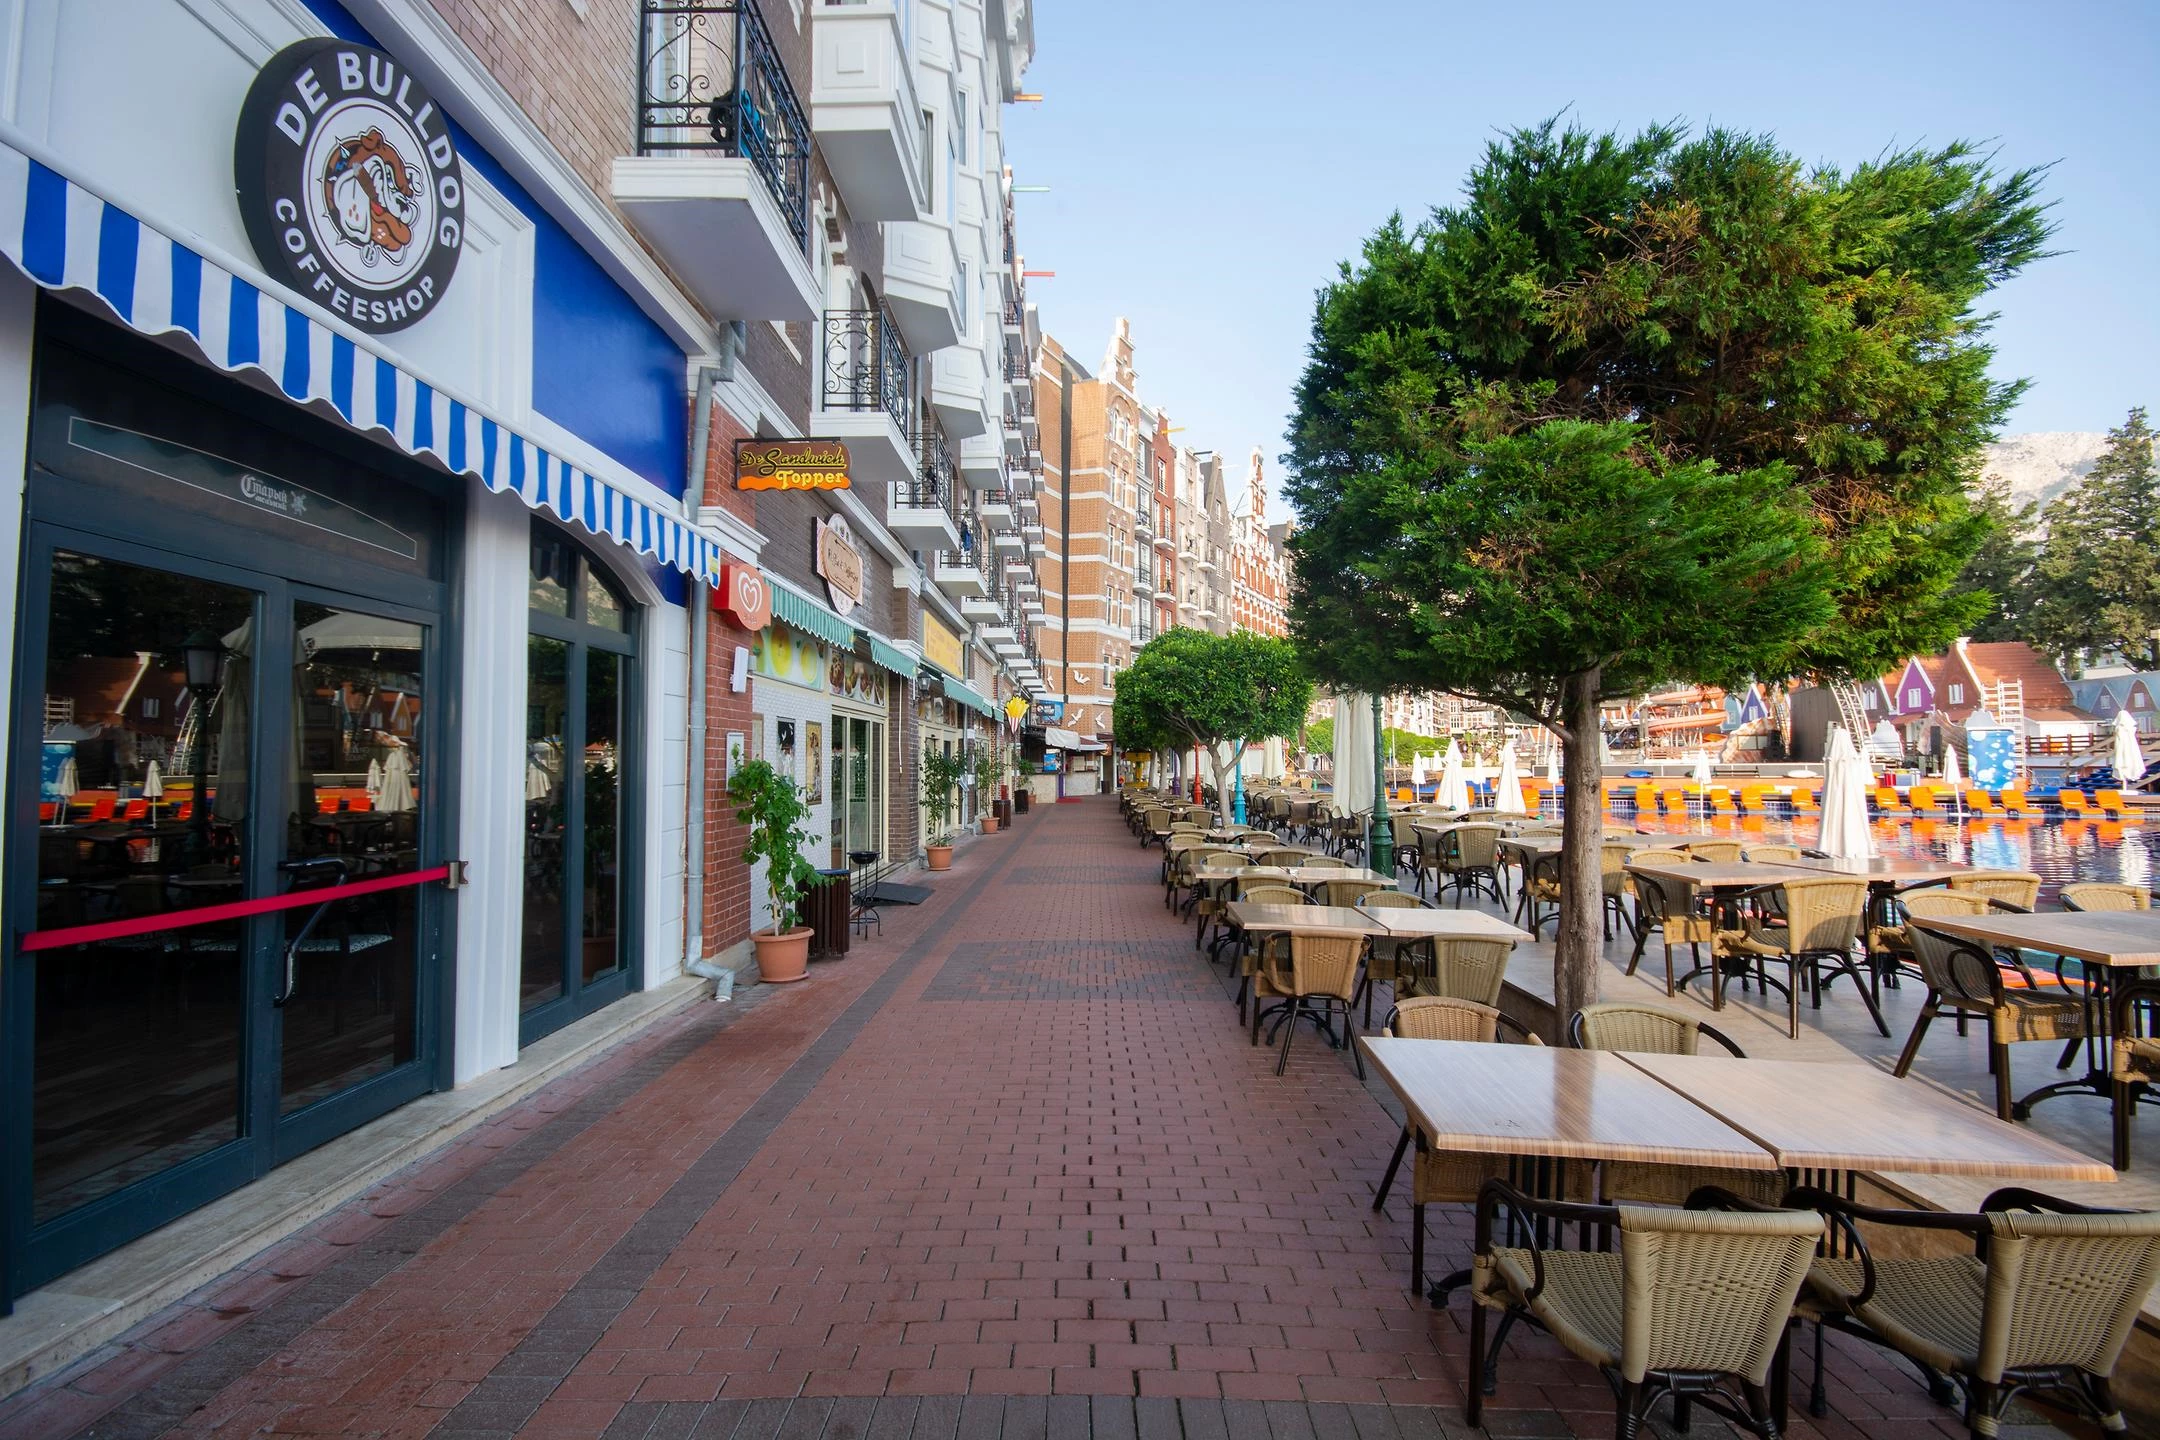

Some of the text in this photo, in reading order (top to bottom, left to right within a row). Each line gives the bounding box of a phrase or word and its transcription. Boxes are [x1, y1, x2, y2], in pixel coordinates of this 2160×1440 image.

[274, 51, 460, 249] DE BULLDOG
[275, 198, 434, 324] COFFEESHOP
[740, 447, 847, 476] De Sandwich
[240, 473, 288, 504] Старый
[775, 470, 844, 490] Topper
